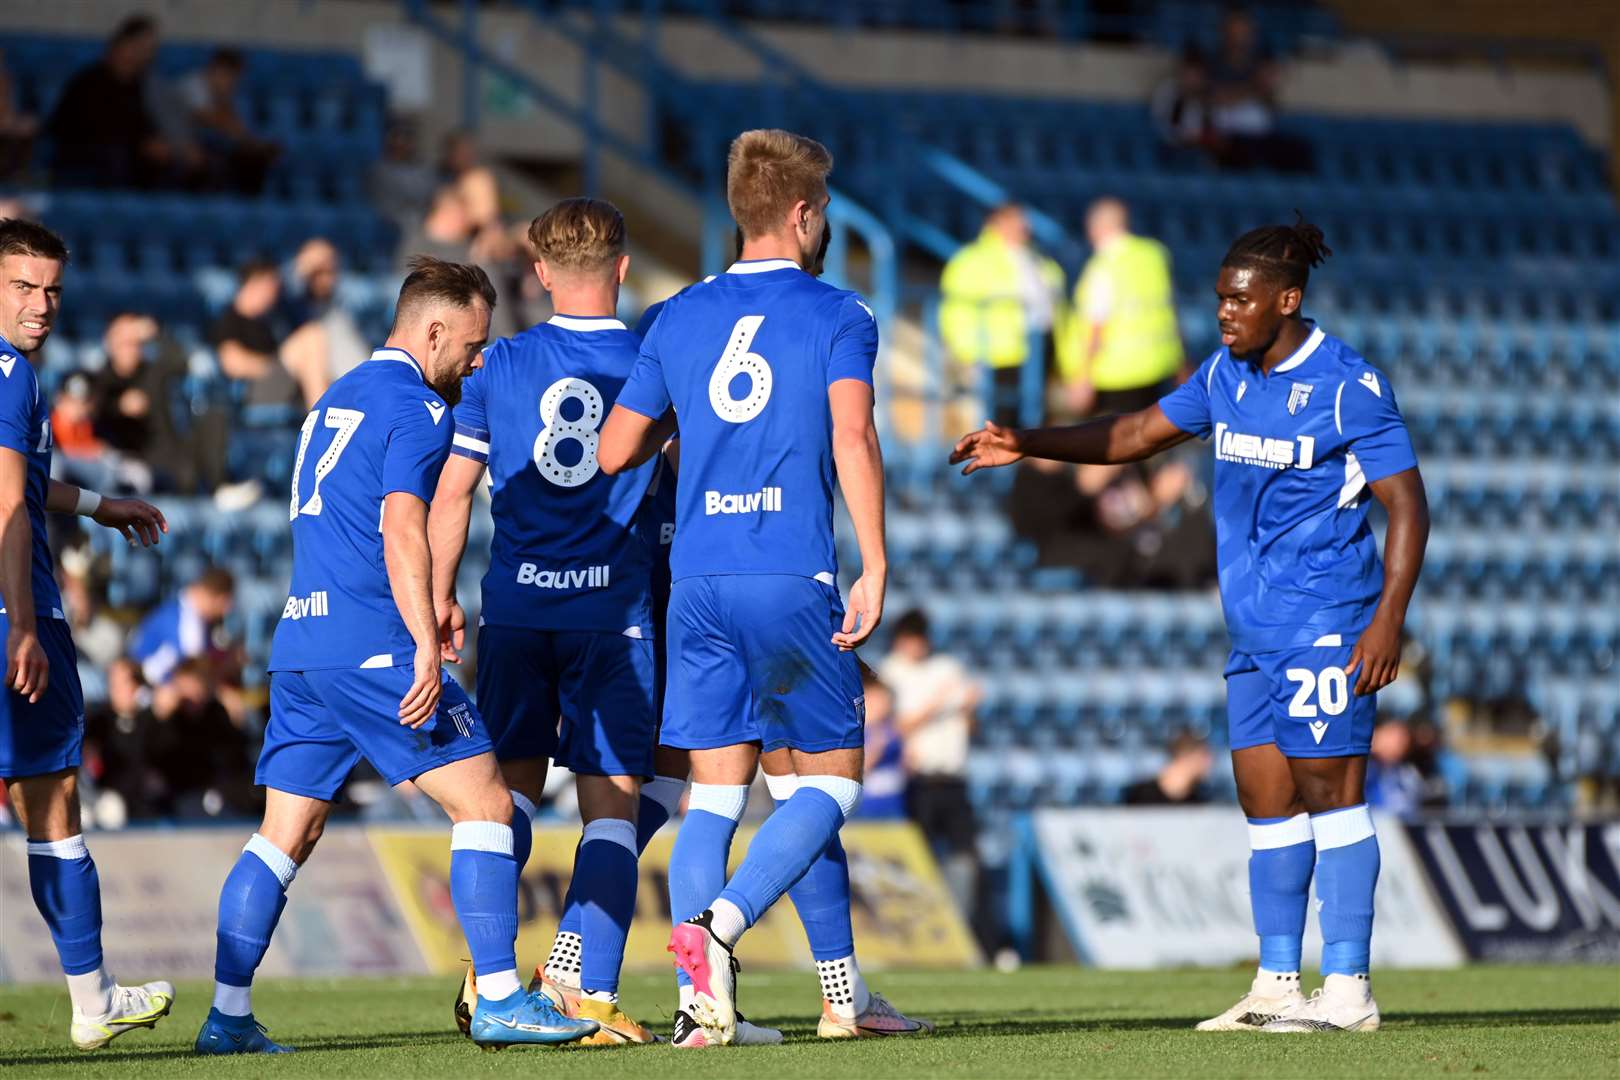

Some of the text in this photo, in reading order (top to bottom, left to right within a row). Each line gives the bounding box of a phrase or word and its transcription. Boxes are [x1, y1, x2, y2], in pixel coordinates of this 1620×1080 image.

[708, 315, 773, 423] 6
[289, 406, 366, 522] 17
[533, 377, 604, 487] 8
[704, 486, 782, 516] Bauvill
[516, 561, 610, 590] Bauvill
[1285, 666, 1348, 718] 20
